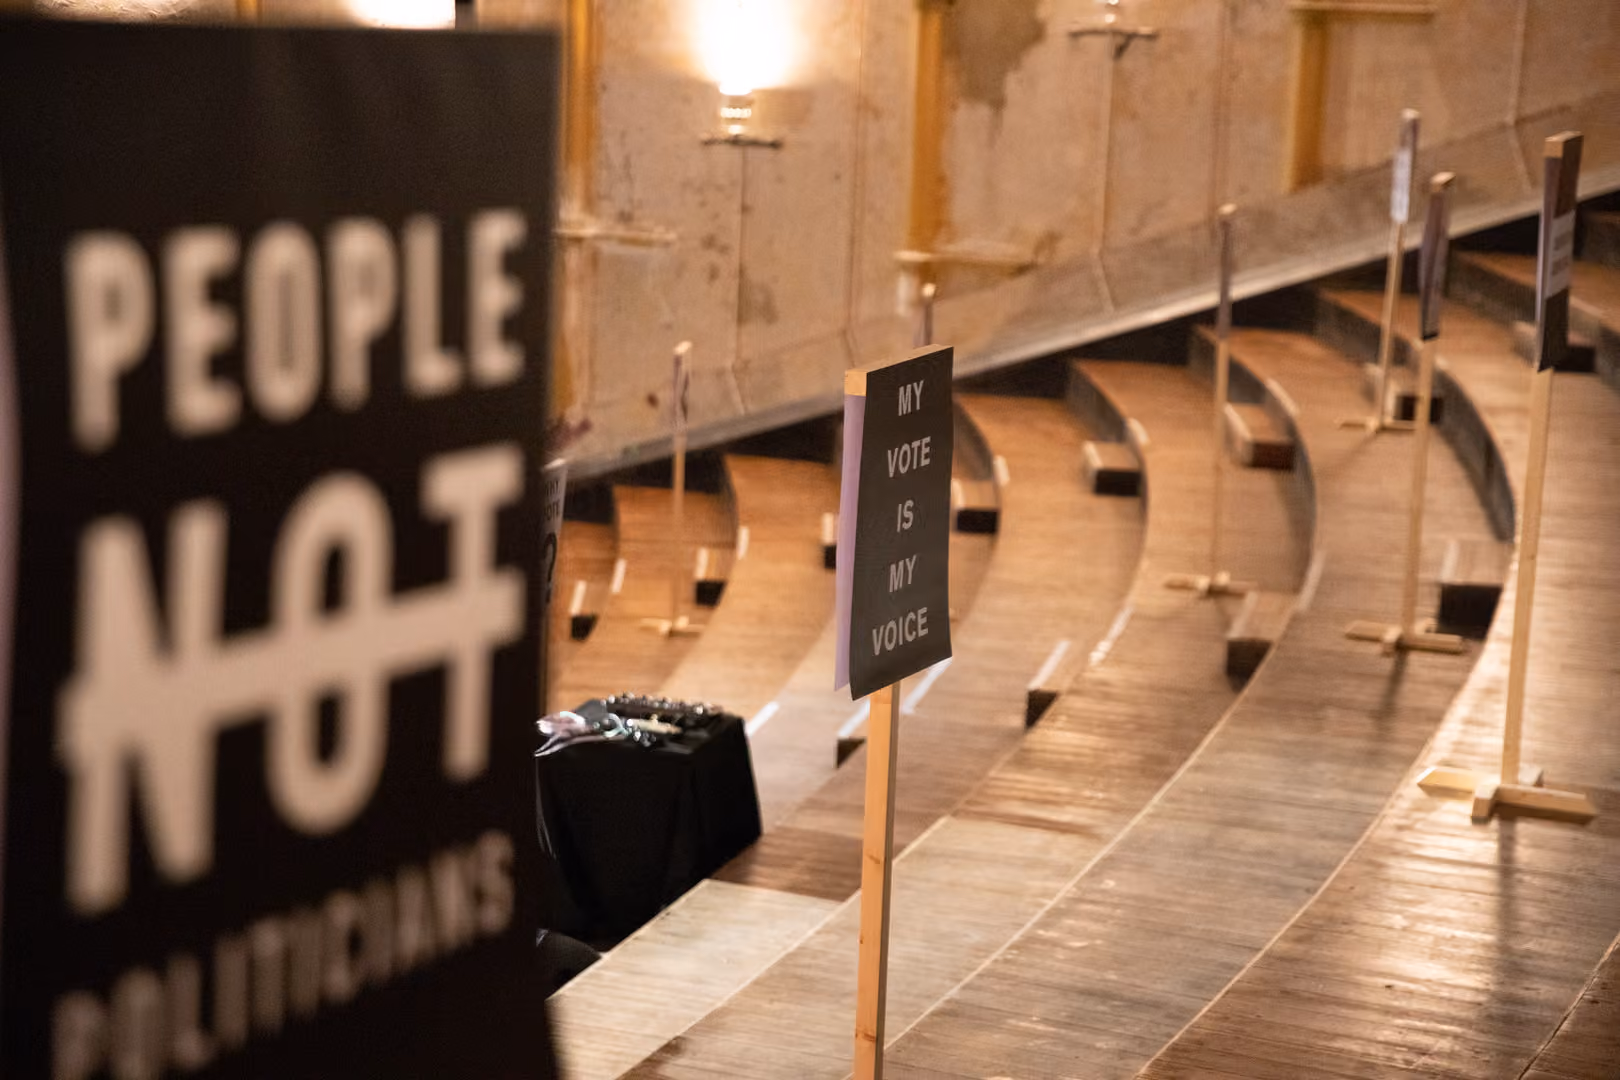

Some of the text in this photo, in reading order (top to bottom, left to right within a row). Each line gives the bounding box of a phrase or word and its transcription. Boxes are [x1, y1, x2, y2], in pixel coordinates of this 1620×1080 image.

[67, 208, 527, 452] PEOPLE
[898, 380, 924, 417] MY
[887, 436, 931, 478] VOTE
[896, 500, 914, 533] IS
[889, 554, 917, 593] MY
[872, 607, 928, 656] VOICE
[57, 443, 527, 916] NOT
[51, 830, 516, 1080] POLITICIANS
